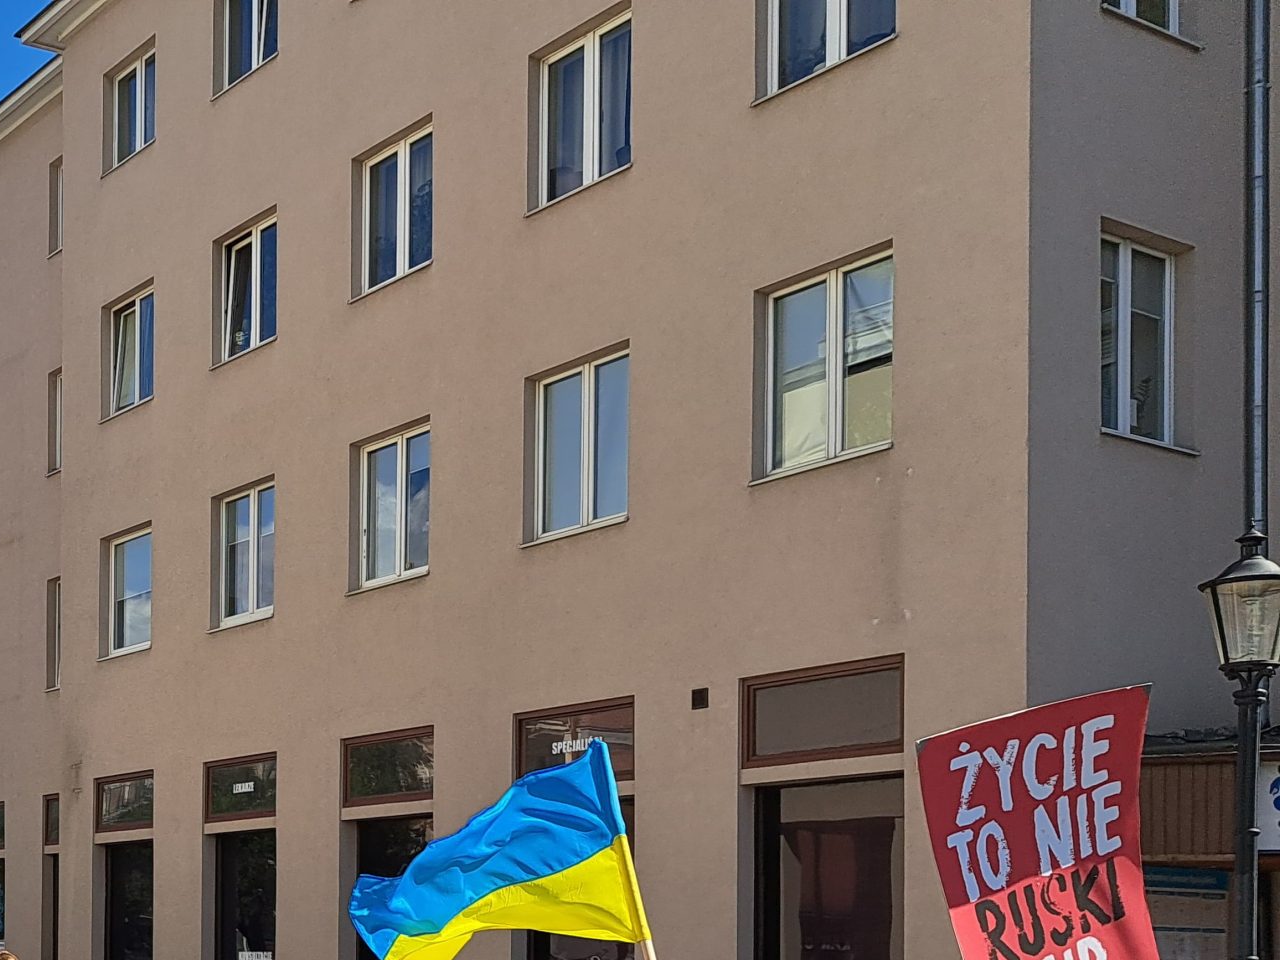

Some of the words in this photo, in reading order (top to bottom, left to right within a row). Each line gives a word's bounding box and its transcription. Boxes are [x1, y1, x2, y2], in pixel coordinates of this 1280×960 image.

[950, 714, 1114, 827] ŻYCIE
[947, 819, 1012, 902] TO
[1034, 781, 1121, 876] NIE
